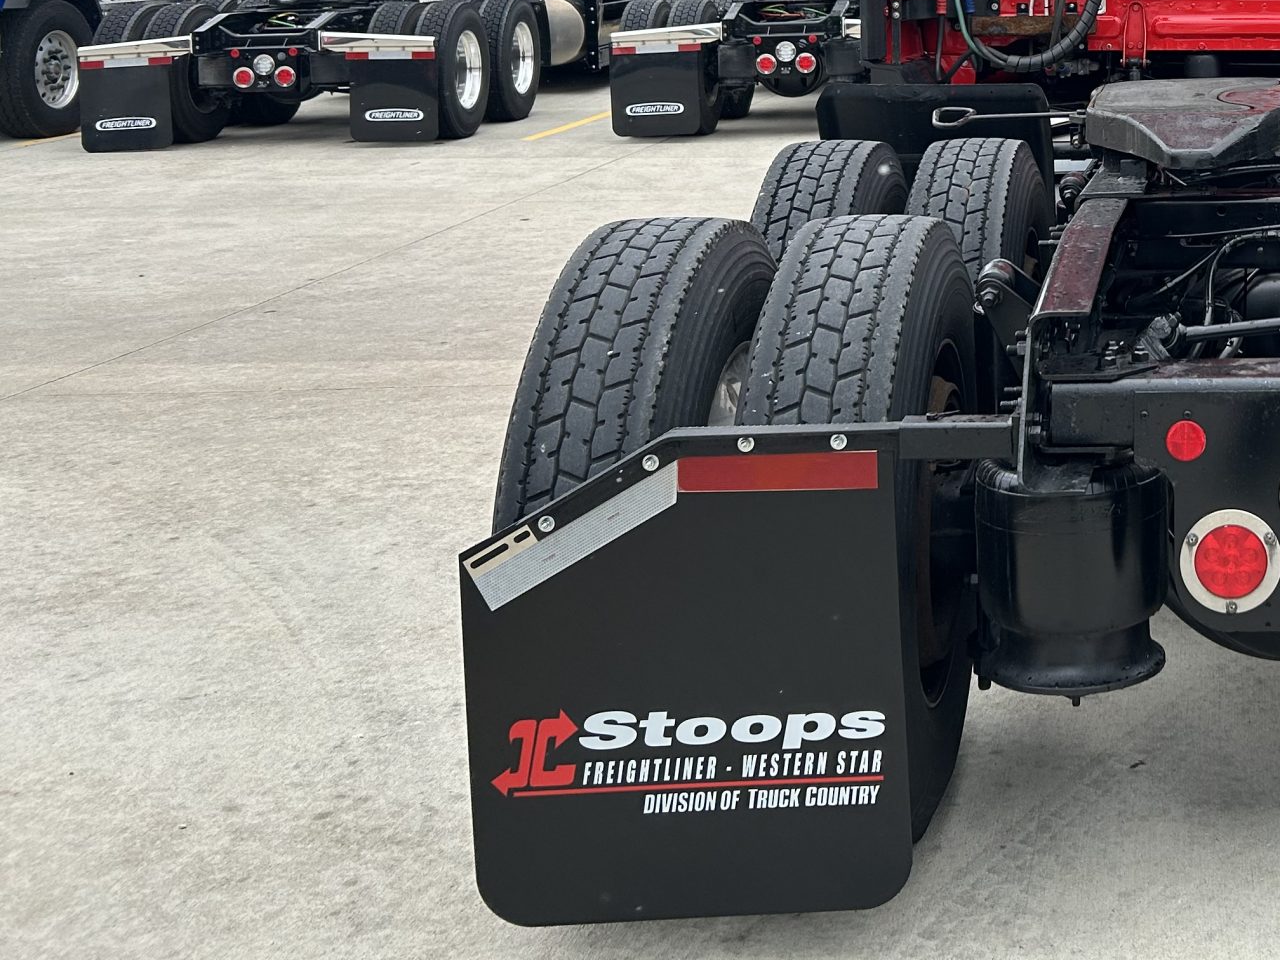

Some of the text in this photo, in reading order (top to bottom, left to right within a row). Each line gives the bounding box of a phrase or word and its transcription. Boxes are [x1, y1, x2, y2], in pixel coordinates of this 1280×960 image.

[371, 111, 418, 119] FREIGHTLINER
[632, 105, 678, 113] FREIGHTLINER
[102, 120, 150, 128] FREIGHTLINER
[579, 711, 886, 750] Stoops
[583, 756, 717, 785] FREIGHTLINER
[742, 752, 828, 777] WESTERN
[837, 750, 883, 774] STAR
[643, 785, 881, 814] DIVISION OF TRUCK COUNTRY
